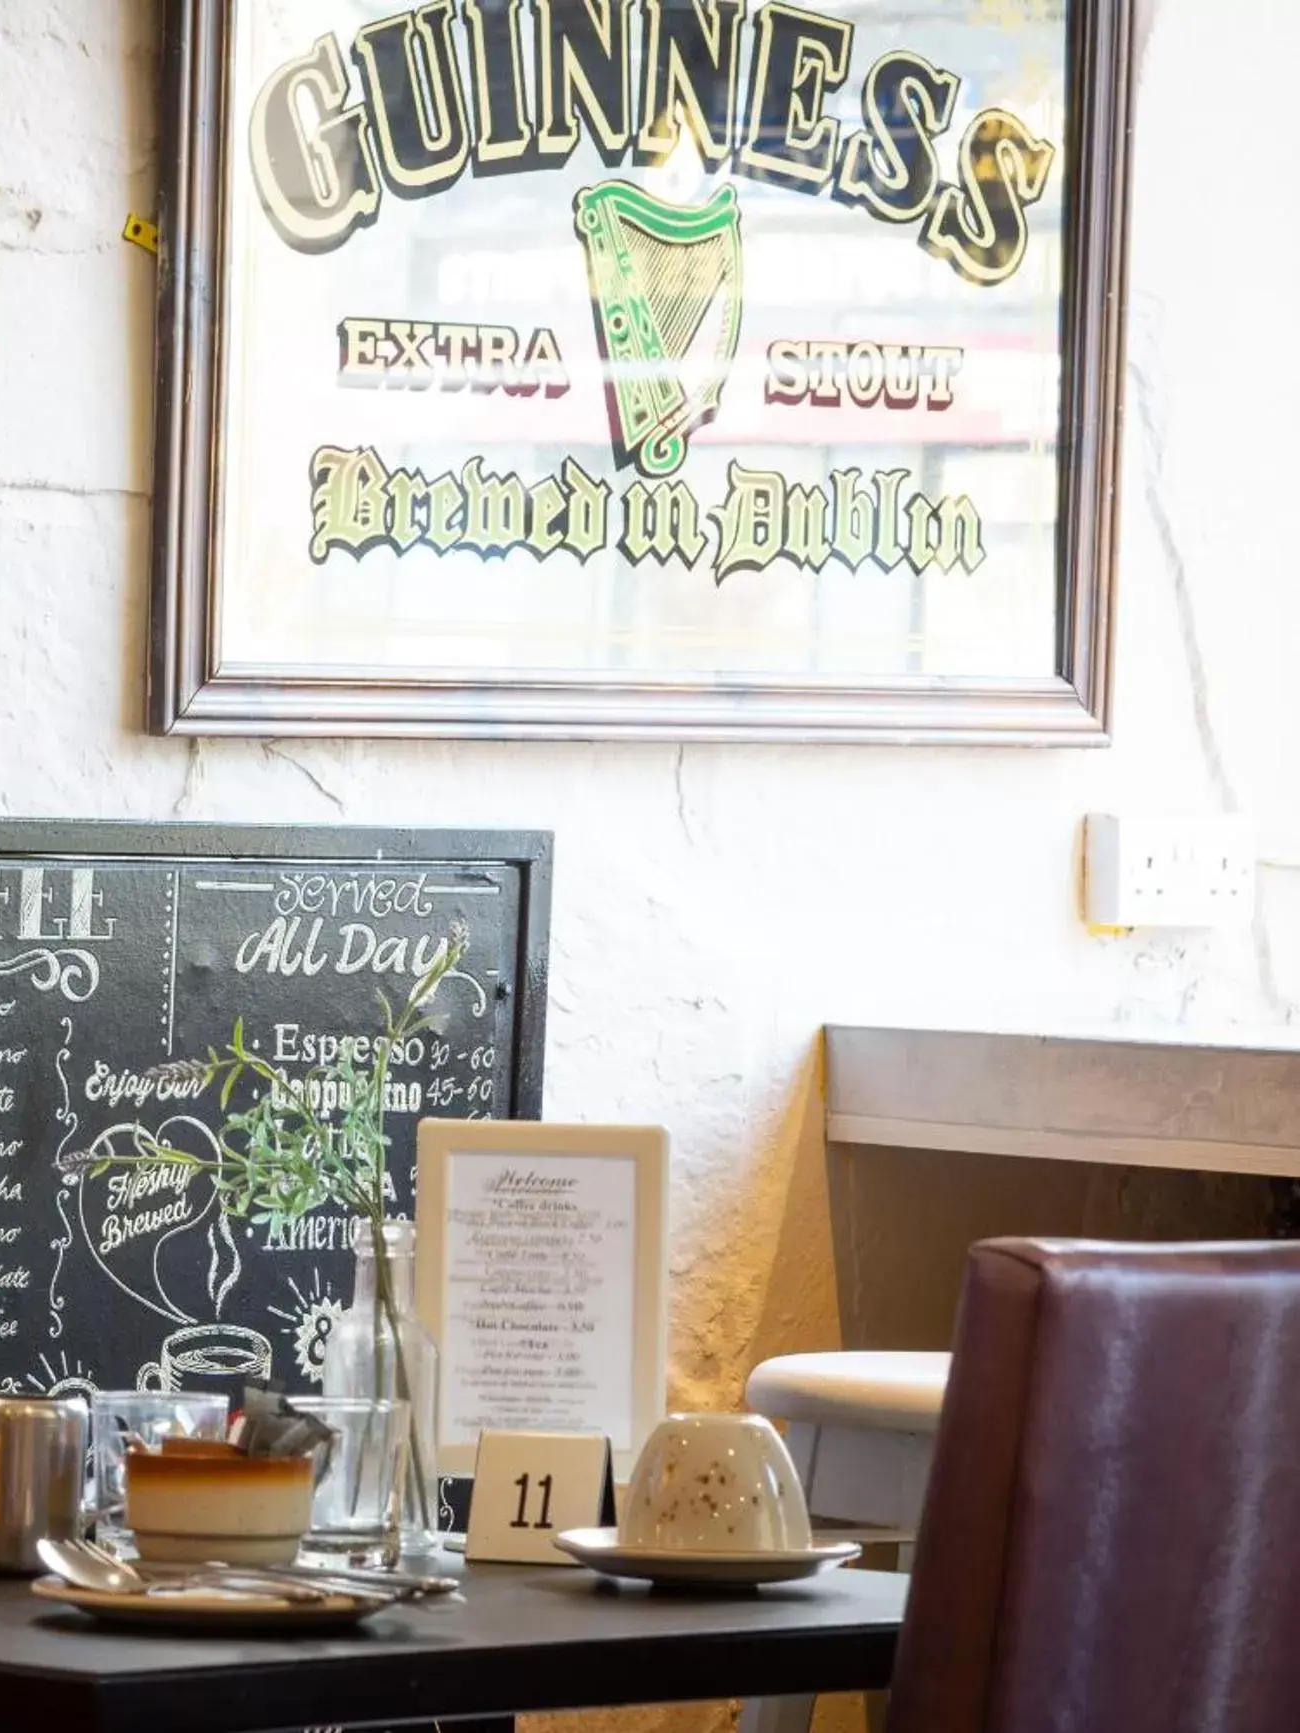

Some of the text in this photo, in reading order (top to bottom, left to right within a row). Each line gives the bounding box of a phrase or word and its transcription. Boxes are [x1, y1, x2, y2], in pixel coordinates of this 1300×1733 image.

[249, 0, 1058, 285] GUINNESS
[337, 318, 964, 410] EXTRA STOUT
[308, 445, 987, 586] Brewed in Dublin
[274, 872, 432, 918] Served
[236, 916, 470, 1010] All Day
[86, 1060, 208, 1107] Enjoy Our
[271, 1066, 422, 1119] Cappuino
[100, 1192, 193, 1256] Brewed
[262, 1213, 402, 1250] Americ
[509, 1471, 553, 1529] 11
